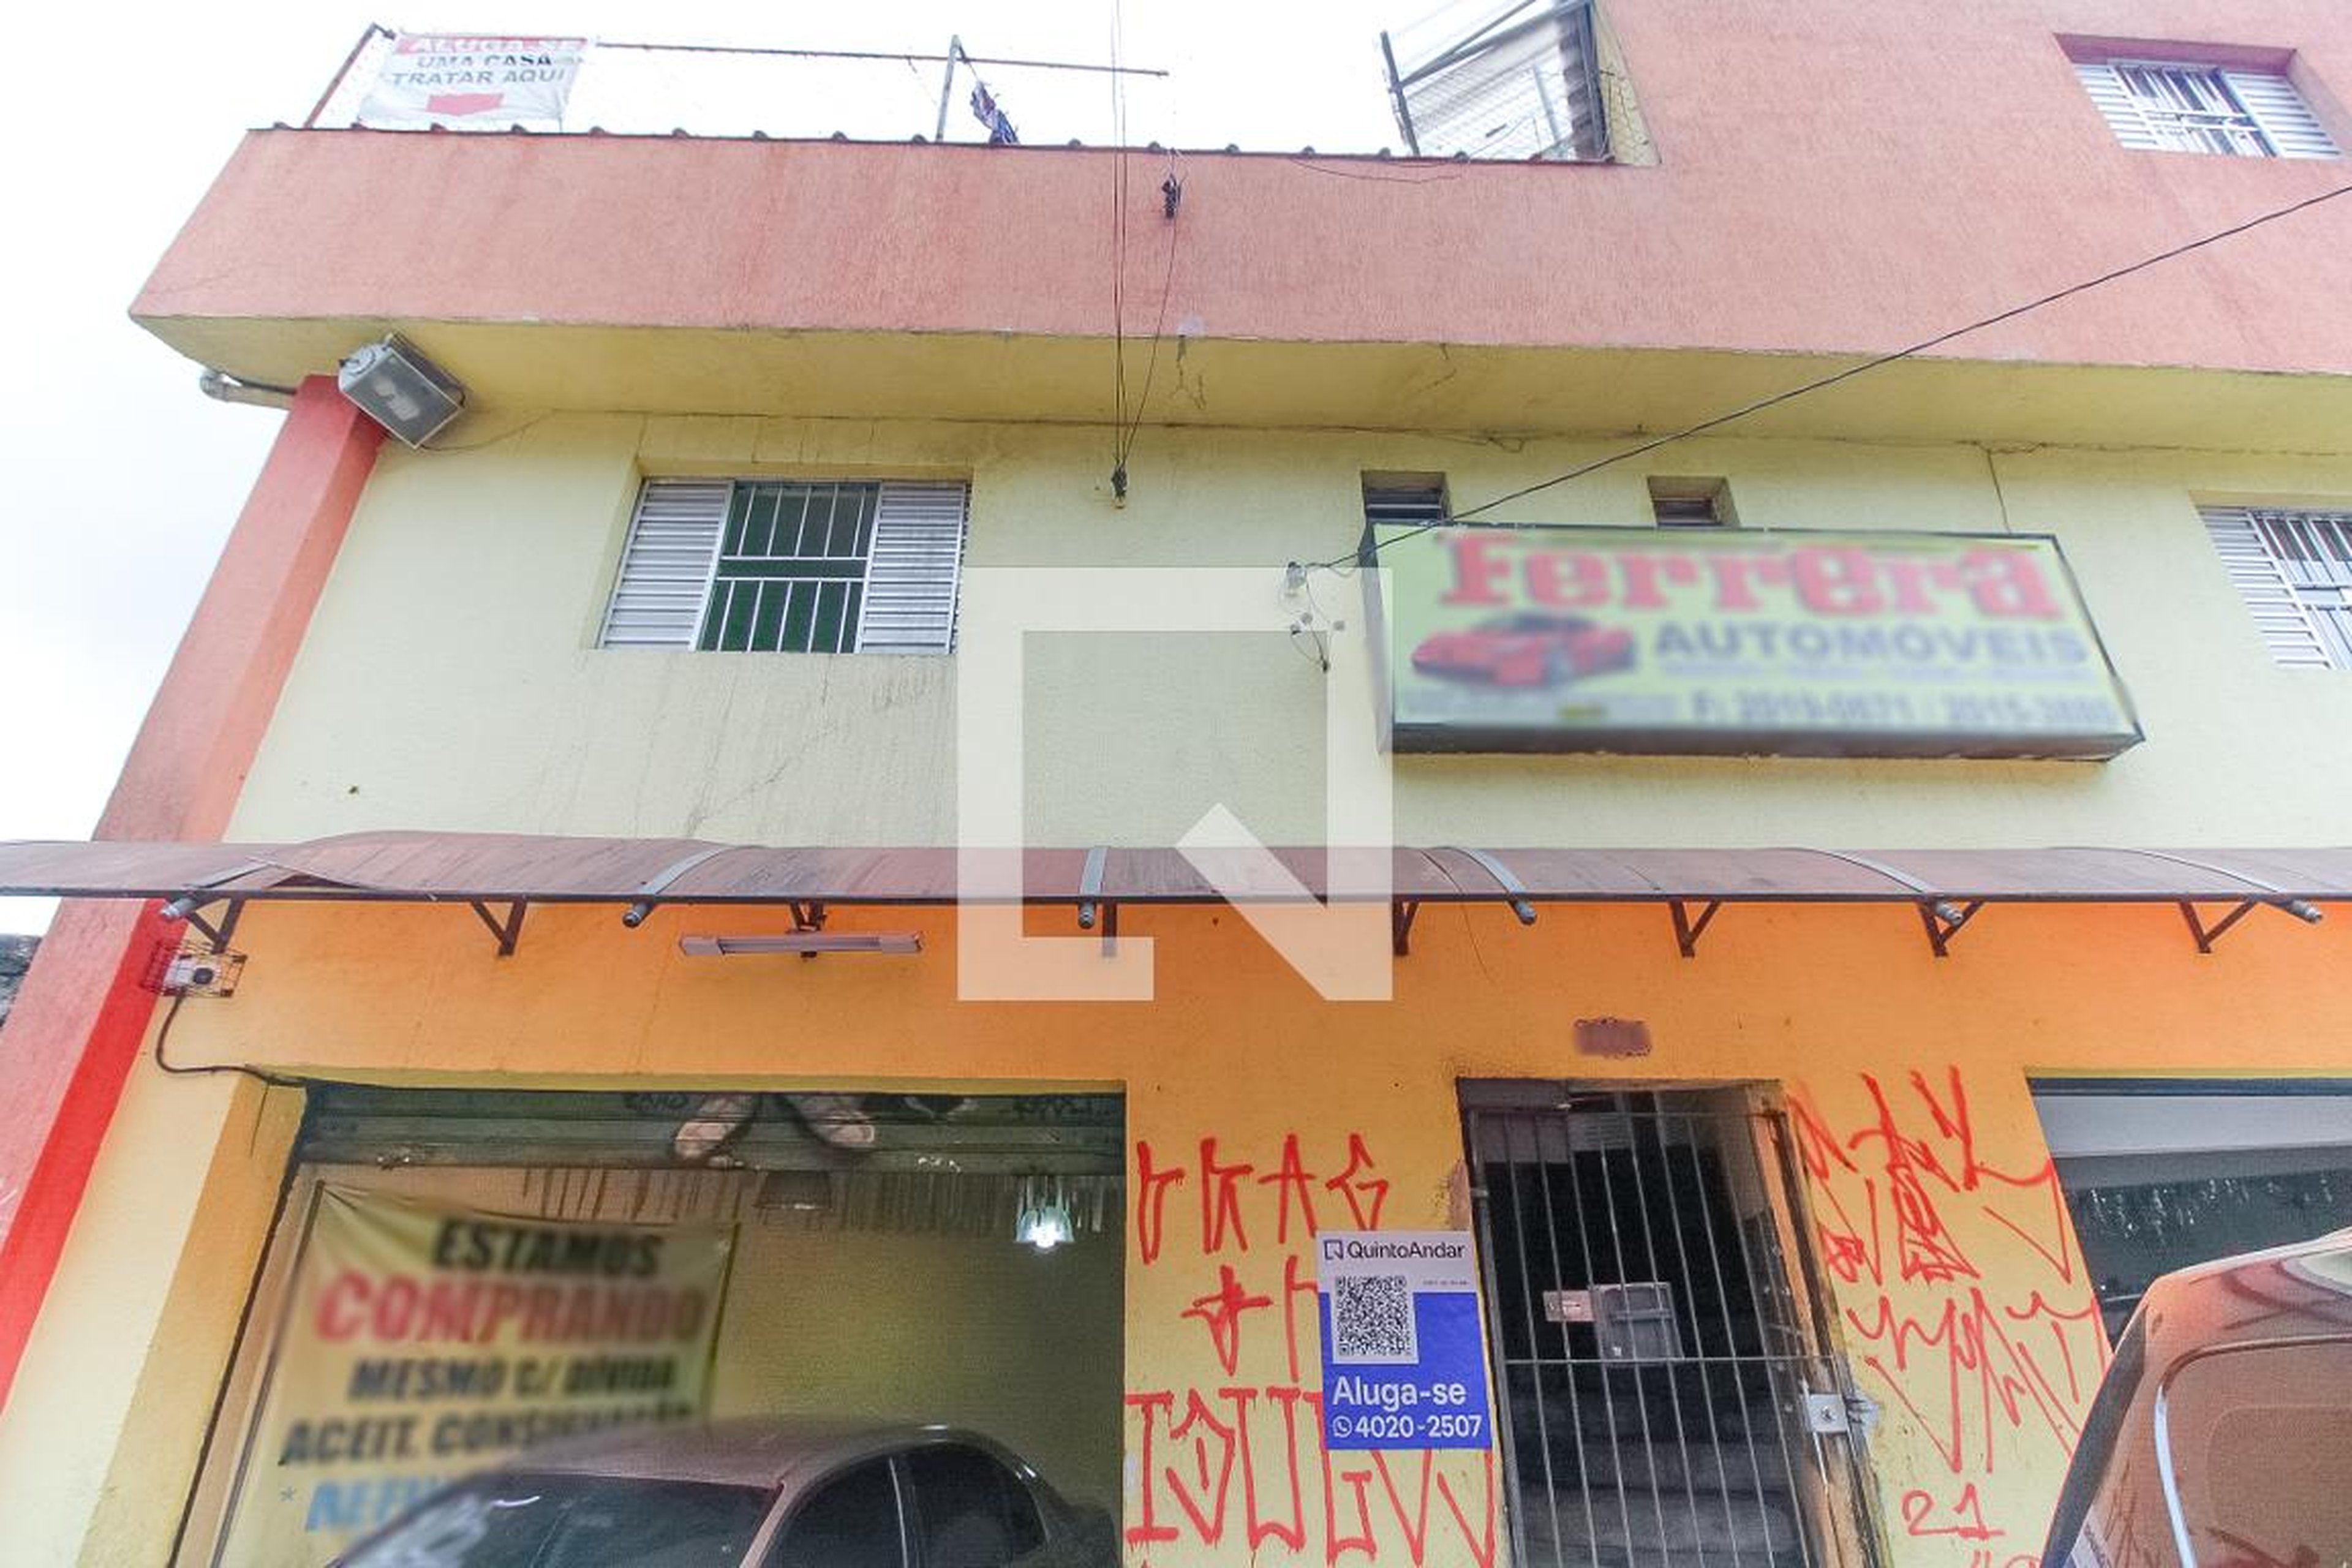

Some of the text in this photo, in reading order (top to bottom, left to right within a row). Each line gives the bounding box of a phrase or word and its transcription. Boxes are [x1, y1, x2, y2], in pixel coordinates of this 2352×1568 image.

[392, 68, 565, 85] TRATAR AQUI
[483, 54, 552, 66] CASA
[1436, 532, 2062, 621] Ferrera
[432, 1218, 664, 1275] ESTAMOS
[1348, 1241, 1466, 1259] QuintoAndar
[314, 1270, 709, 1344] COMPRANDO
[348, 1357, 506, 1401] MESMO
[1332, 1376, 1466, 1411] Aluga-se
